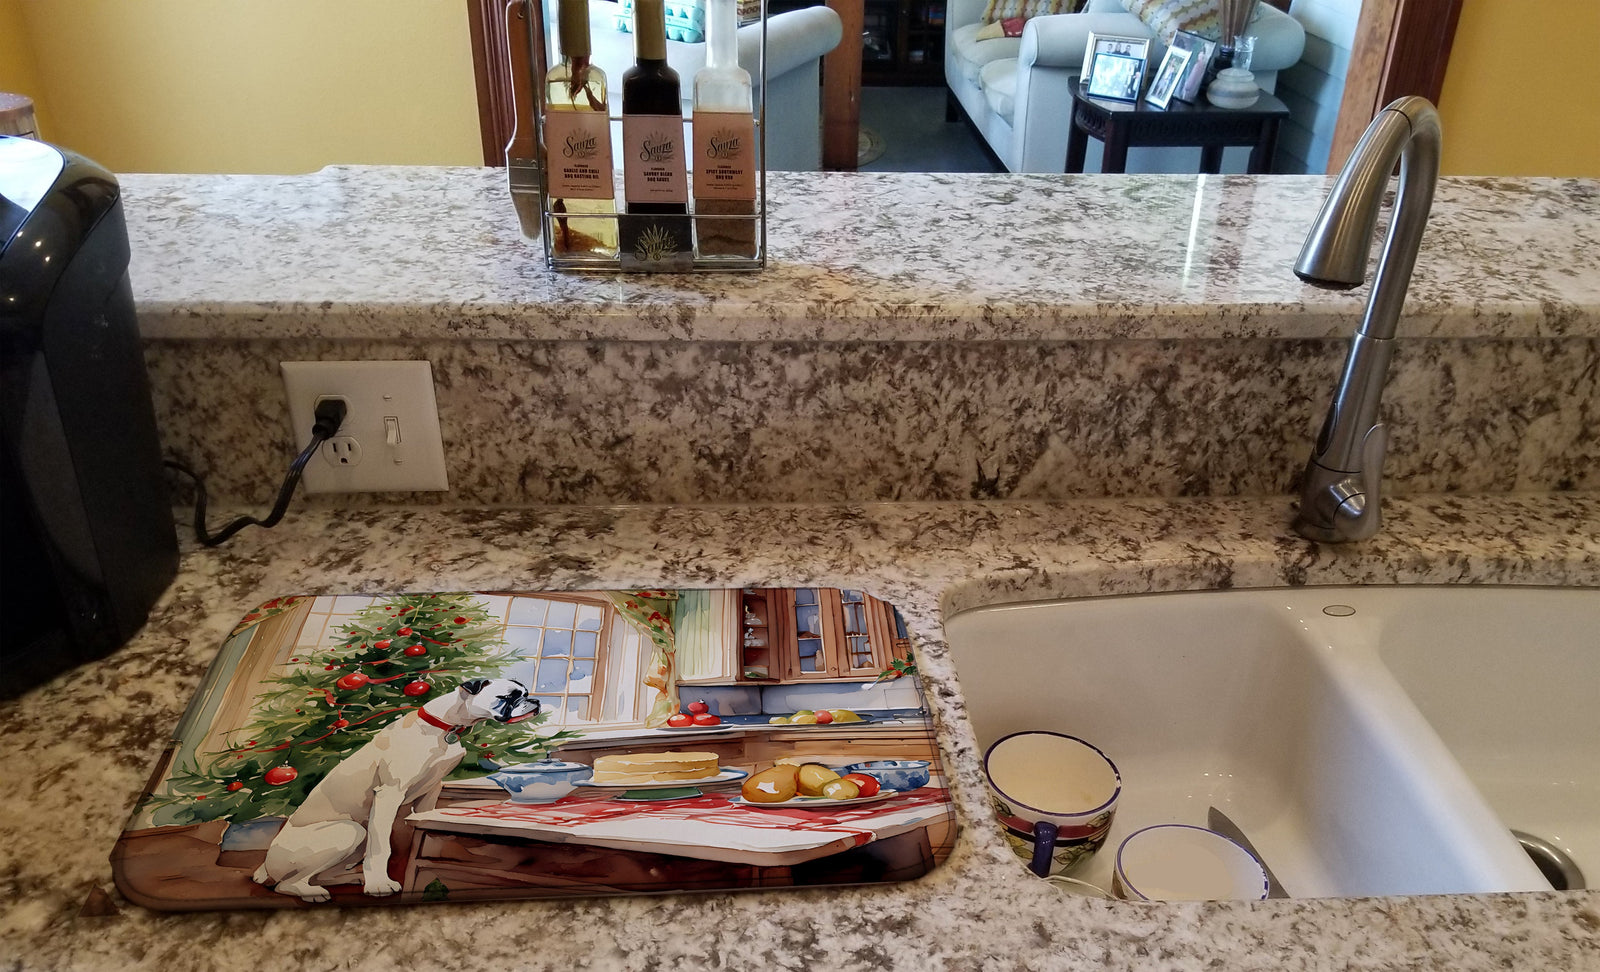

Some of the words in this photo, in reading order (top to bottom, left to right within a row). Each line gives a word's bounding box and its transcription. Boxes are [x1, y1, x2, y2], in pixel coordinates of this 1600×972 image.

[562, 136, 596, 158] Sauza
[640, 140, 673, 162] Sauza
[707, 136, 740, 159] Sauza
